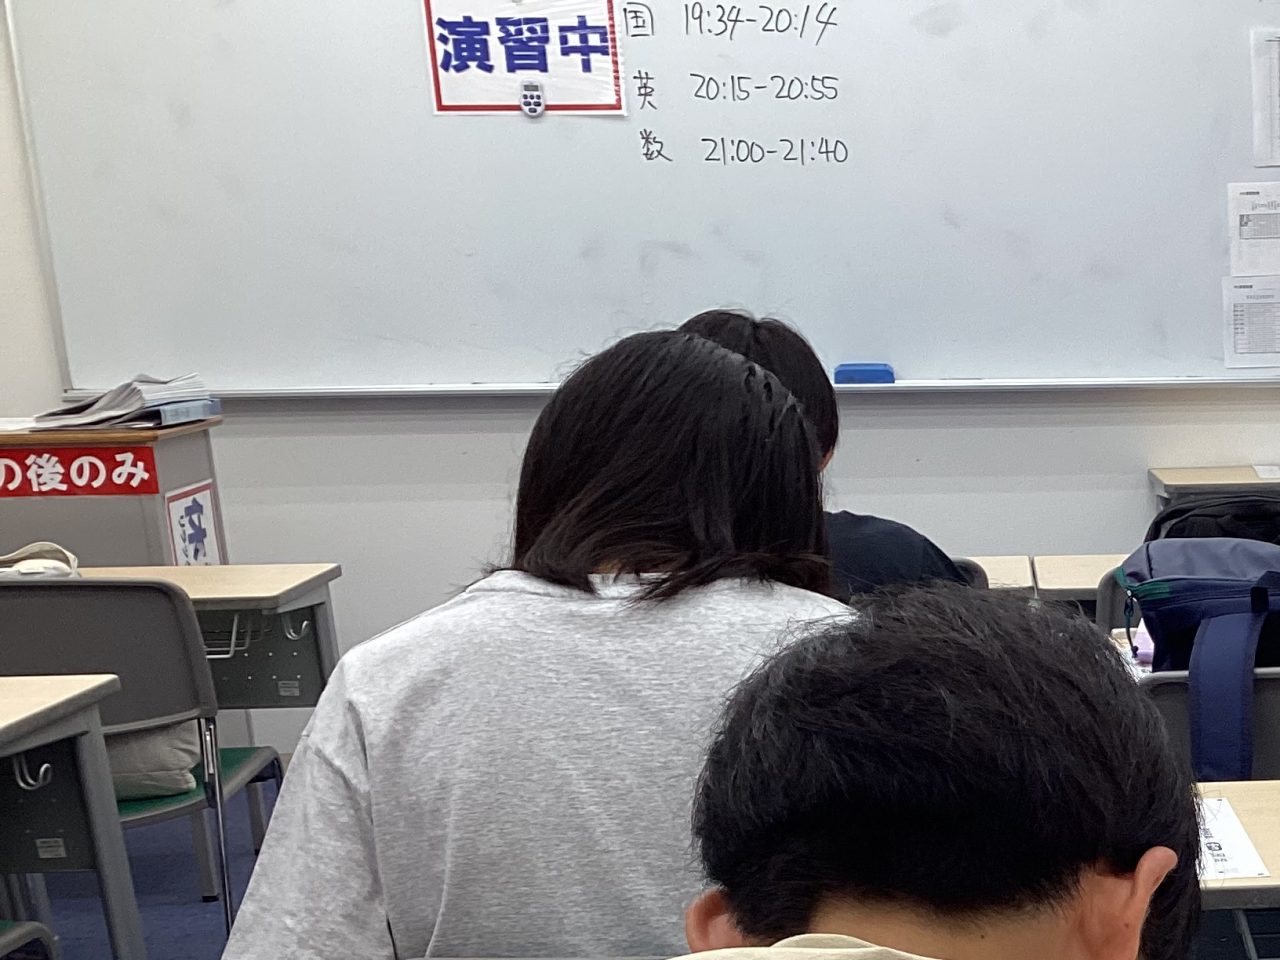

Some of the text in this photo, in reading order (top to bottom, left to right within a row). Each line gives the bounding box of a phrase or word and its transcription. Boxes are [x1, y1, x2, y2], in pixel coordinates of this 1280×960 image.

[436, 15, 610, 73] 演習中
[623, 2, 837, 46] 国 19:34-20:14
[633, 71, 839, 109] 英 20:15-20:55
[639, 129, 848, 164] 数 21:00-21:40
[0, 452, 150, 492] の後のみ
